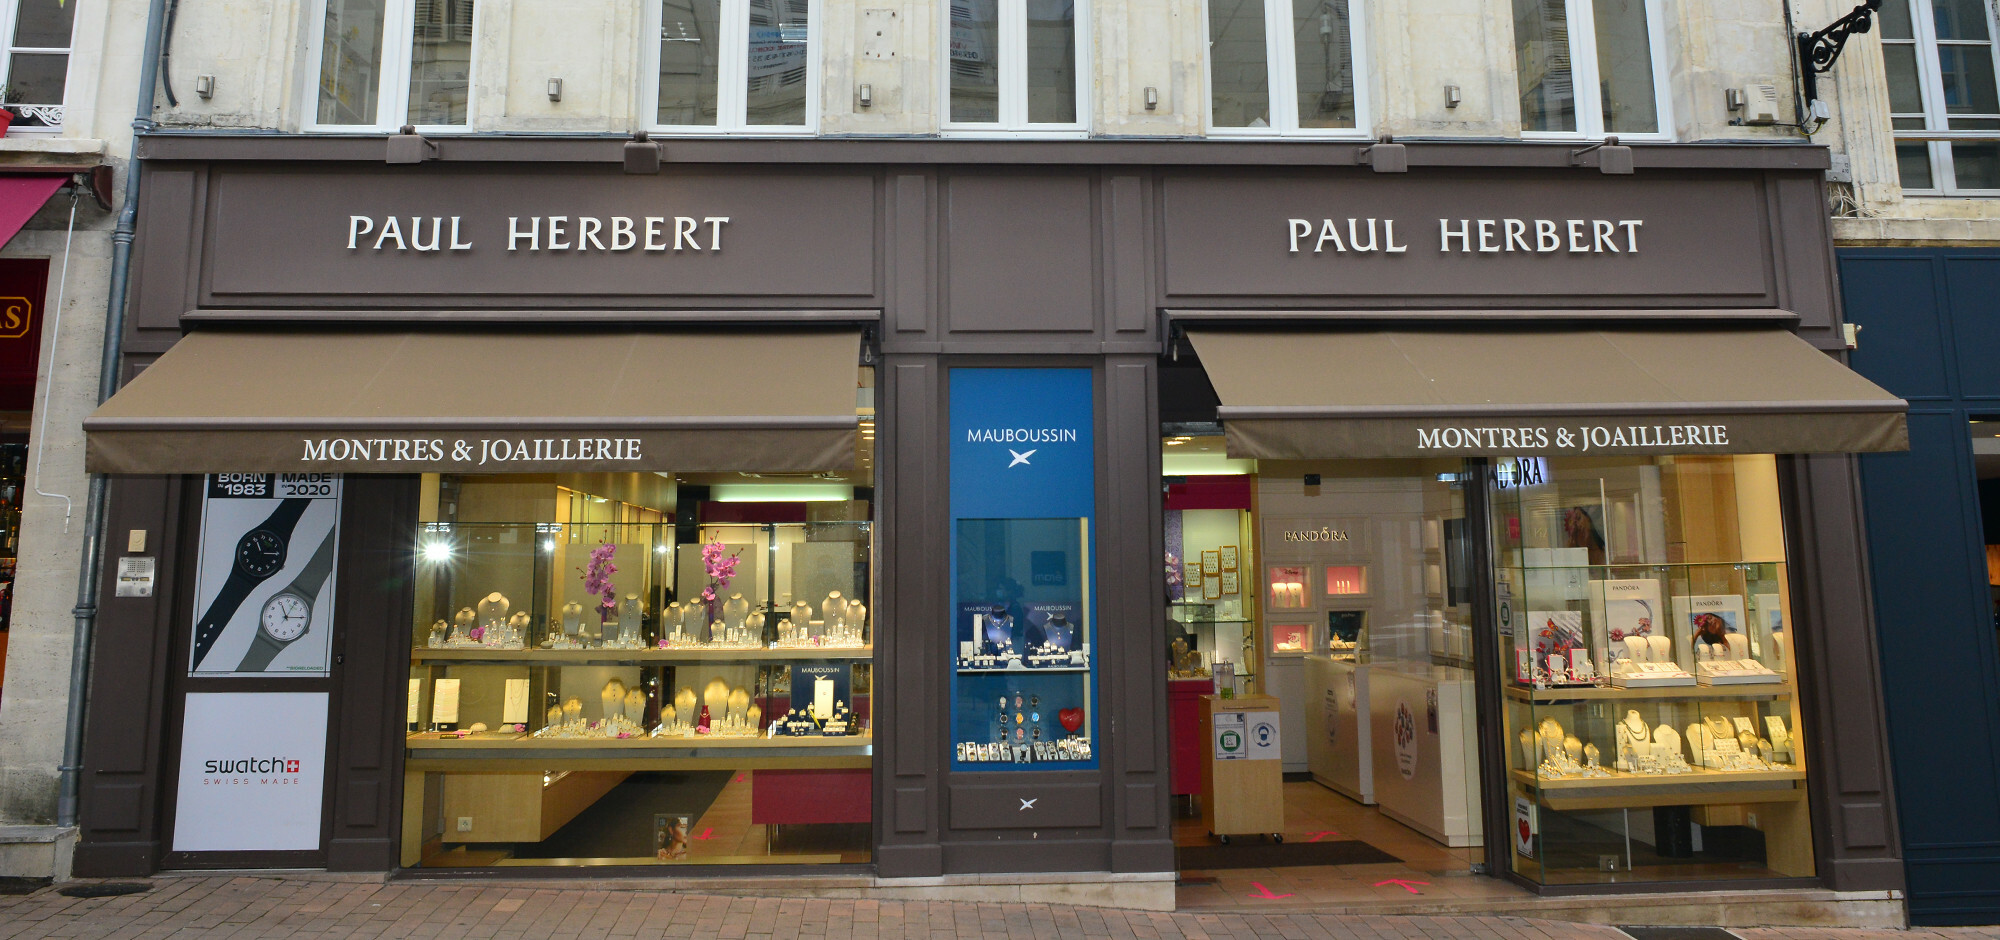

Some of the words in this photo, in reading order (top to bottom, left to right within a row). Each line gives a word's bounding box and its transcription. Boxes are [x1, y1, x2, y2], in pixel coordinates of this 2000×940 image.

[346, 215, 472, 251] PAUL
[507, 215, 730, 251] HERBERT
[1288, 218, 1408, 252] PAUL
[1439, 218, 1643, 253] HERBERT
[0, 305, 21, 329] S
[967, 428, 1076, 442] MAUBOUSSIN
[1416, 427, 1549, 449] MONTRES
[1555, 427, 1576, 448] &
[1580, 425, 1729, 452] JOAILLERIE
[301, 438, 444, 461] MONTRES
[451, 439, 473, 462] &
[478, 438, 642, 466] JOAILLERIE
[217, 472, 266, 483] BORN
[281, 472, 332, 483] MADE
[224, 483, 267, 496] 1983
[286, 484, 331, 496] 2020
[204, 756, 285, 774] swatch
